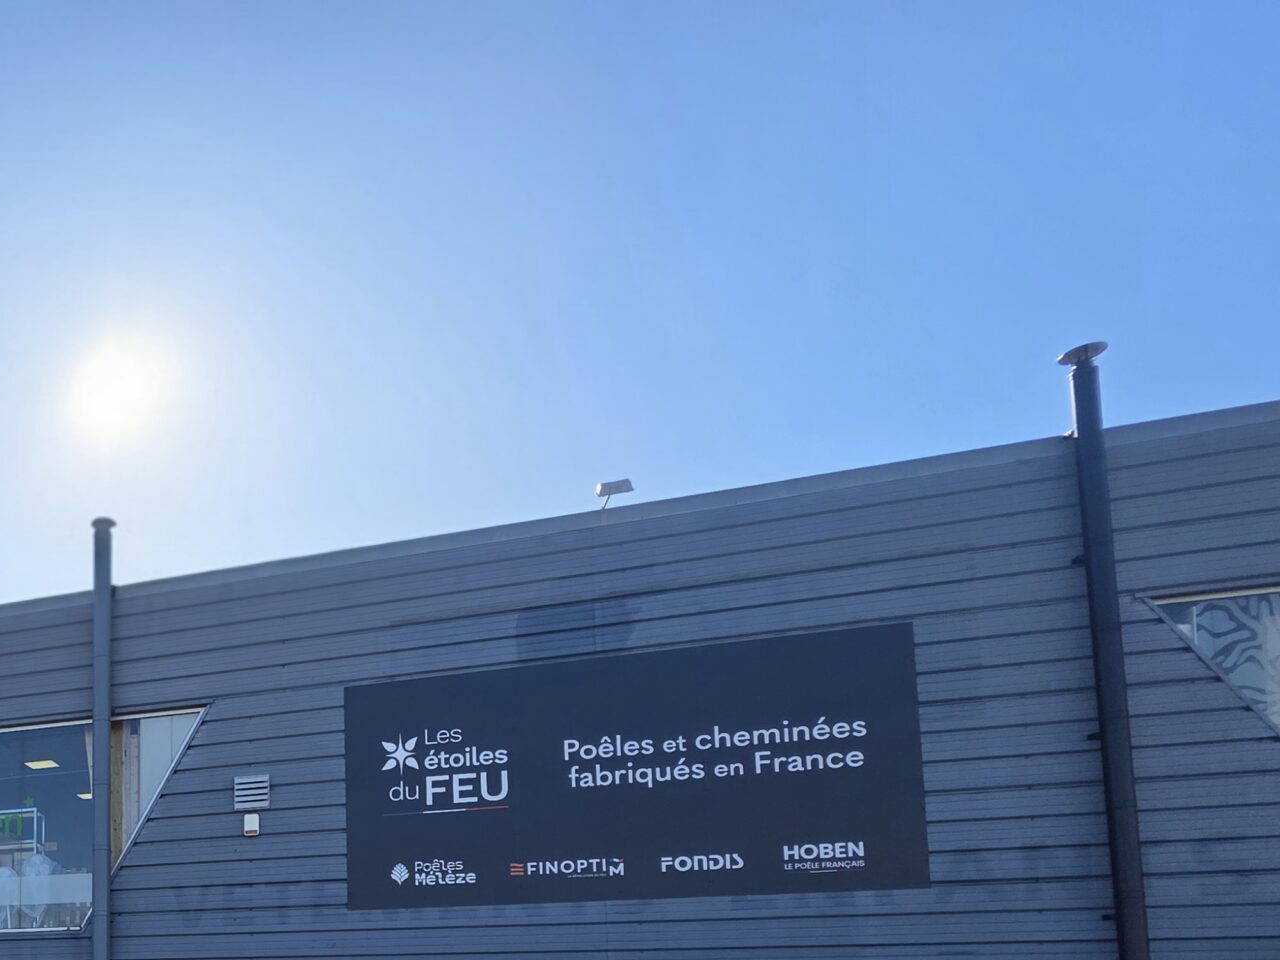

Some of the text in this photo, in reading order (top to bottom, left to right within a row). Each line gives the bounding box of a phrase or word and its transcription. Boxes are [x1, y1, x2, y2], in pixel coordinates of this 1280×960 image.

[425, 728, 463, 745] Les
[563, 716, 868, 761] Poêles et cheminées
[424, 746, 508, 770] étoiles
[568, 750, 865, 789] fabriqués en France
[389, 770, 509, 806] du FEU
[783, 841, 865, 861] HOBEN
[414, 859, 464, 873] Poêles
[526, 858, 625, 877] FINOPTIM
[660, 853, 745, 873] FONDIS
[821, 860, 865, 869] FRANÇAIS
[414, 870, 477, 886] Mélèze
